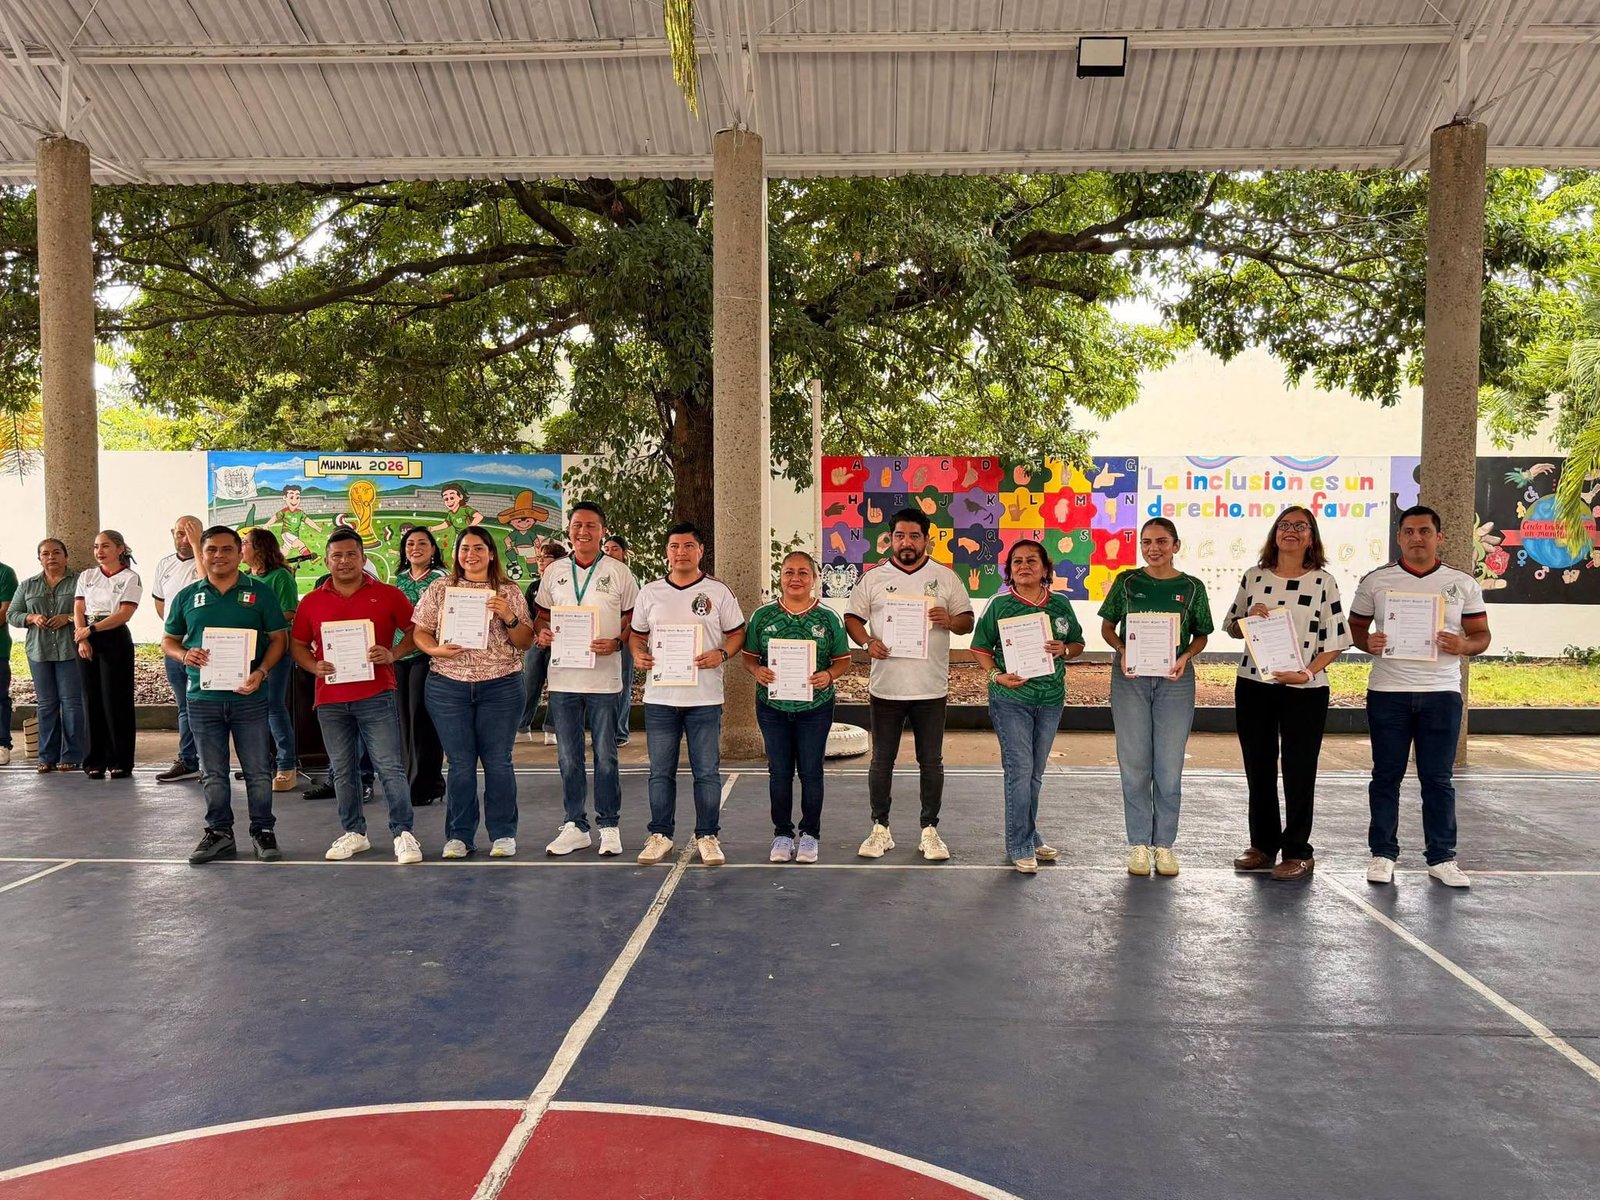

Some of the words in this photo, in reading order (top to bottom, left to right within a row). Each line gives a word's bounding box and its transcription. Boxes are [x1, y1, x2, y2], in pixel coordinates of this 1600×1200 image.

[320, 460, 362, 470] MUNDIAL
[369, 461, 404, 471] 2026
[852, 460, 862, 471] A
[894, 460, 902, 471] B
[941, 460, 950, 471] C
[982, 460, 991, 470] D
[1125, 459, 1136, 471] G
[1186, 468, 1303, 490] inclusión
[1310, 475, 1339, 490] es
[1345, 476, 1374, 490] un
[848, 494, 858, 504] H
[894, 494, 903, 506] I
[939, 494, 948, 507] J
[986, 494, 996, 506] K
[1029, 494, 1038, 505] L
[1075, 495, 1087, 506] M
[1125, 495, 1134, 505] N
[1147, 495, 1245, 517] derecho,
[1248, 503, 1276, 517] no
[939, 530, 948, 541] P
[986, 530, 996, 542] Q
[1033, 530, 1041, 540] R
[1080, 530, 1089, 541] S
[1124, 531, 1133, 542] T
[984, 564, 995, 575] W
